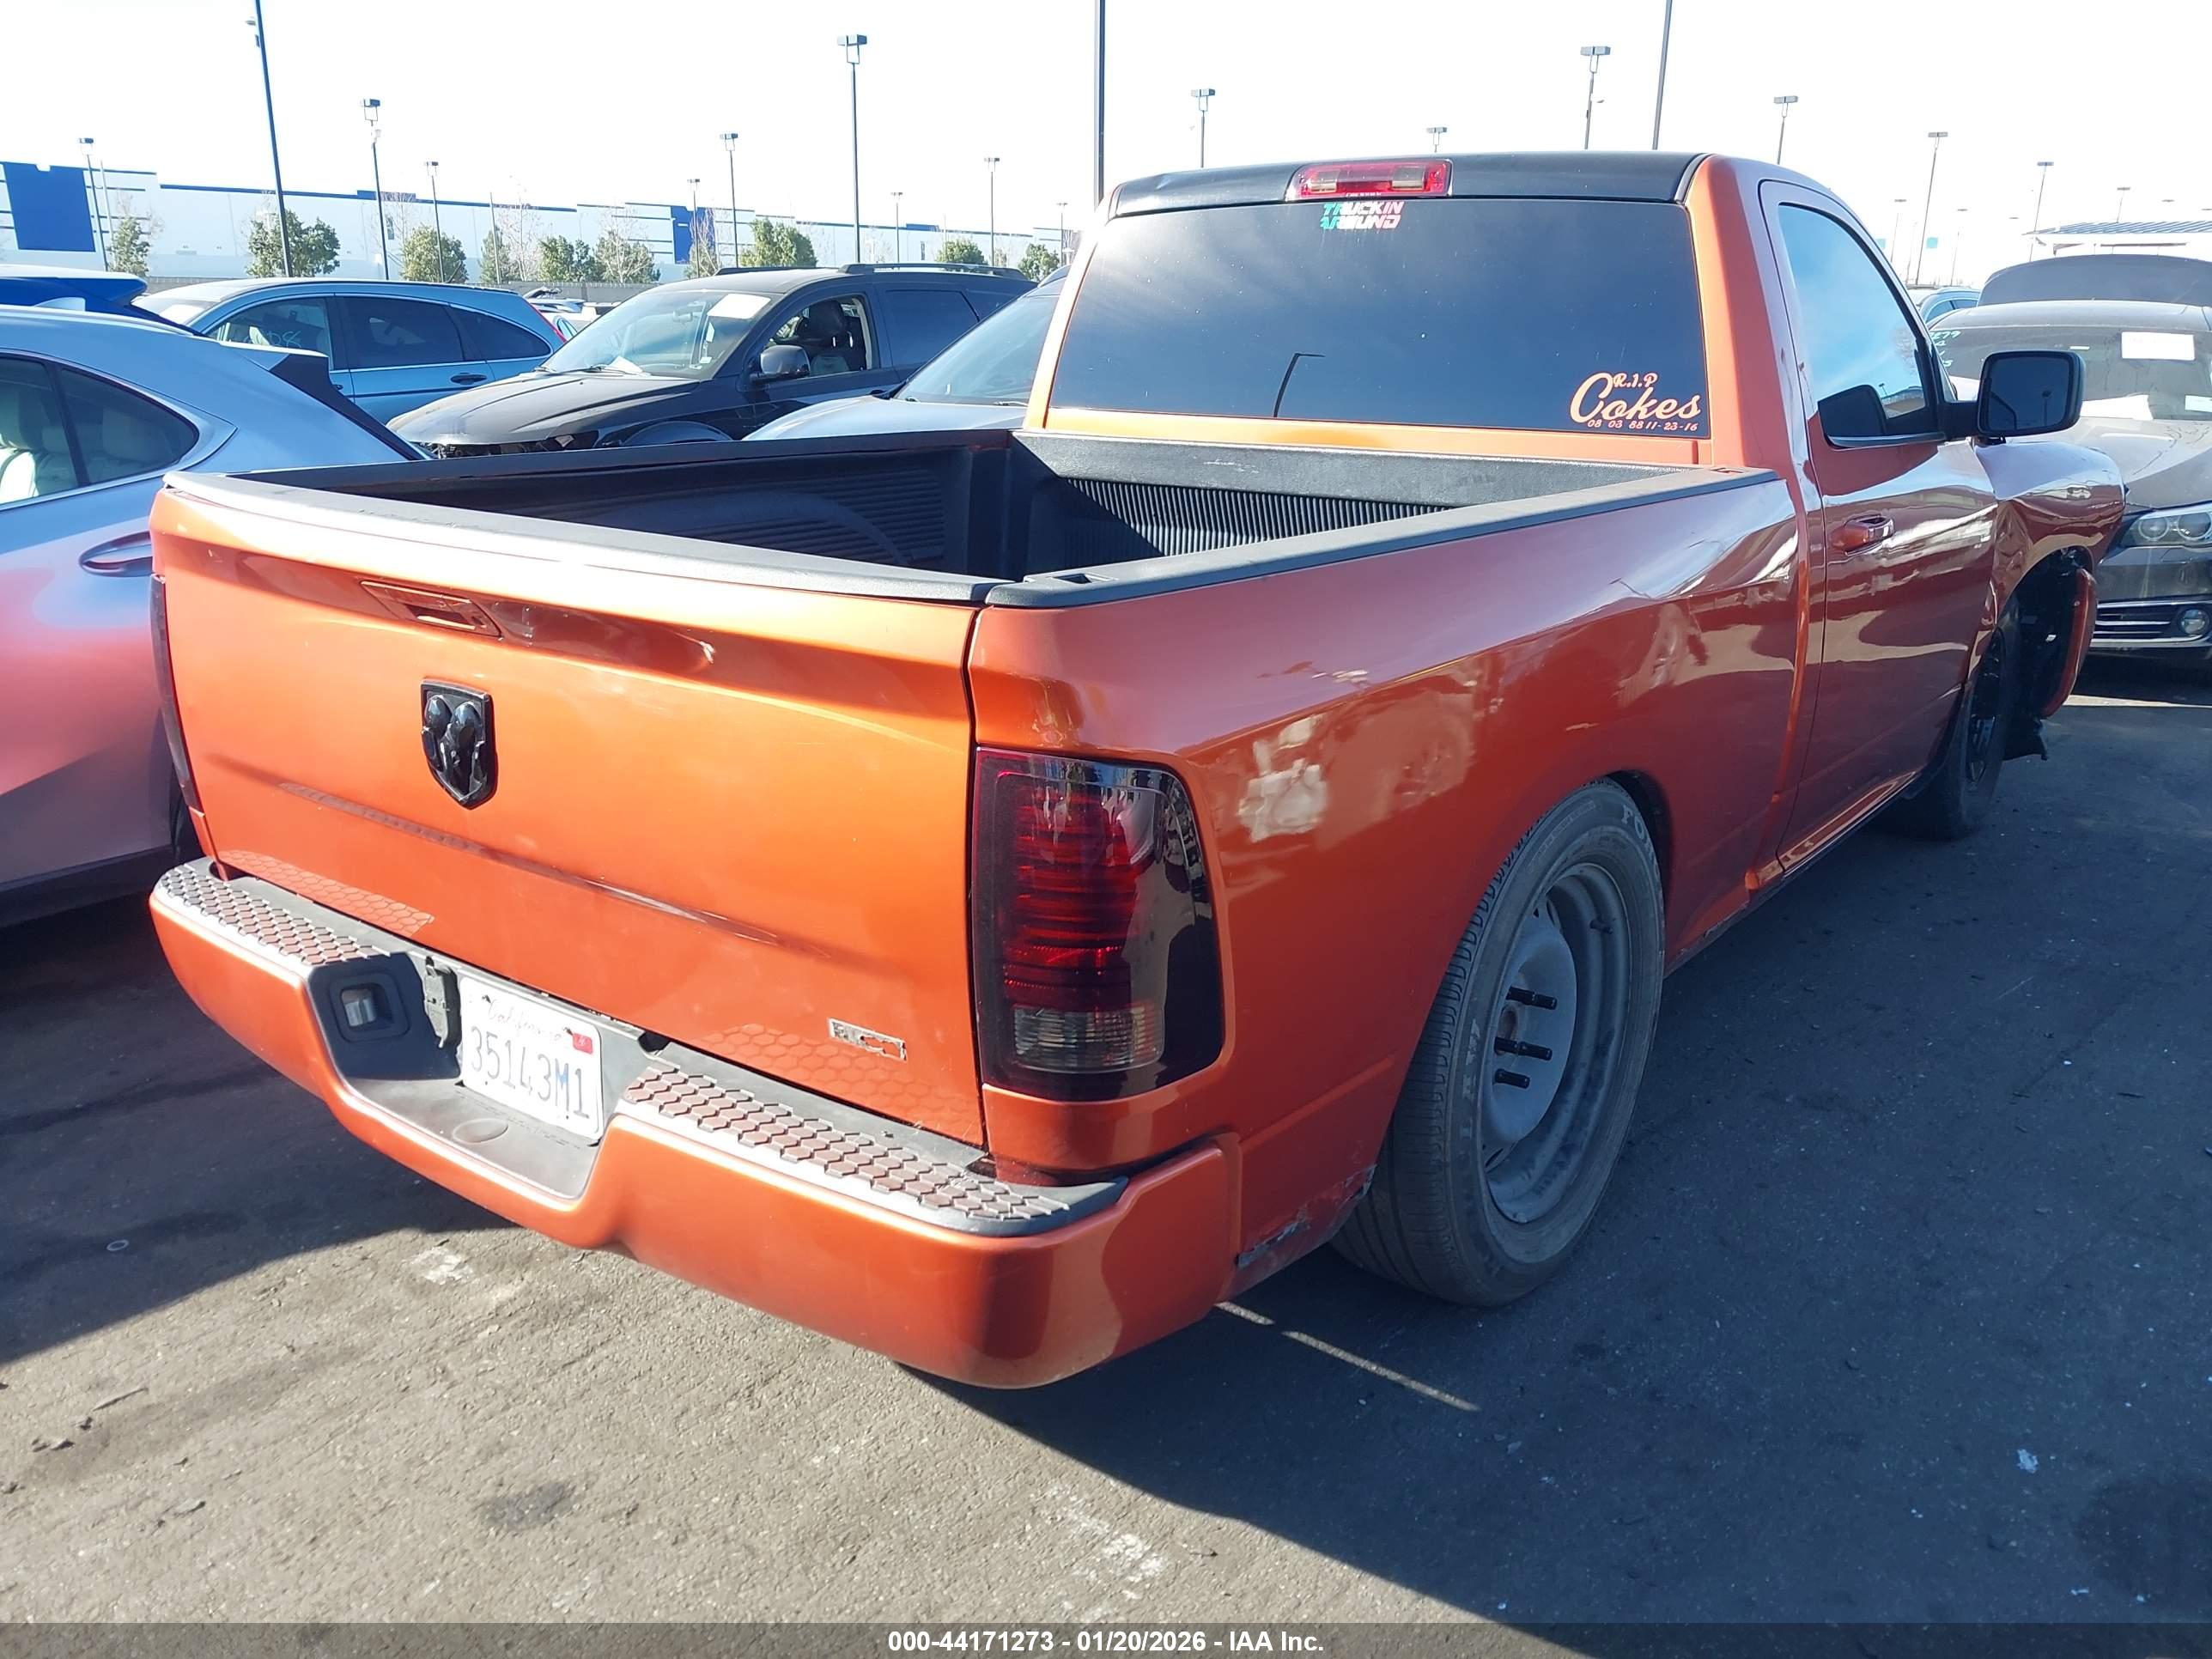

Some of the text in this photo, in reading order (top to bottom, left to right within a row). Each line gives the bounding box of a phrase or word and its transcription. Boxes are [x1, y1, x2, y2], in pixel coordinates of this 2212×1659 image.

[1322, 201, 1405, 216] TRUCKIN
[1570, 372, 1701, 423] Cokes
[470, 1025, 591, 1120] 35143M1
